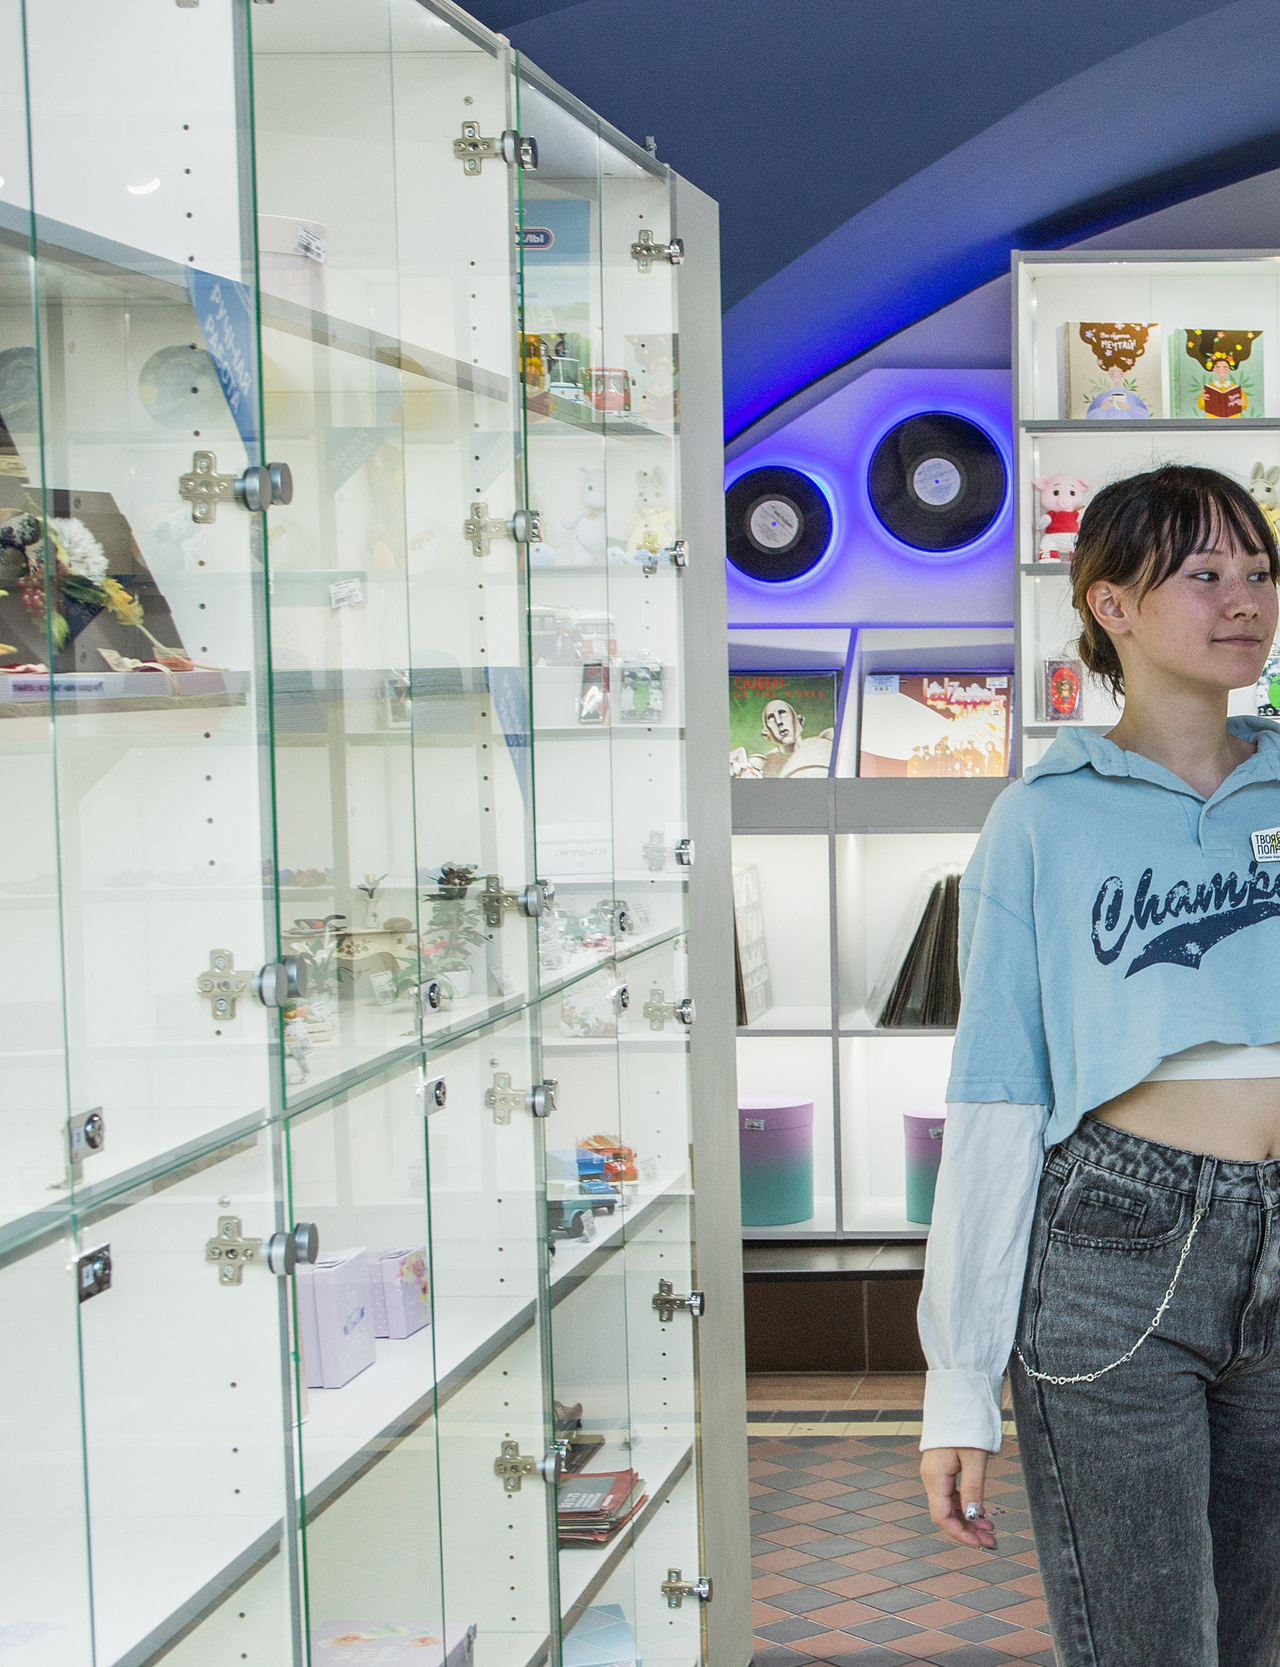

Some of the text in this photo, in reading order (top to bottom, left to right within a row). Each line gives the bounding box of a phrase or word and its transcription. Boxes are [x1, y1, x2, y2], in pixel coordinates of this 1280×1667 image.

[203, 314, 240, 416] РАБОТА
[734, 677, 784, 690] QUEEN
[923, 678, 954, 702] Led
[756, 690, 778, 698] THE
[785, 690, 825, 698] WORLD
[1254, 833, 1277, 845] ТВОЯ
